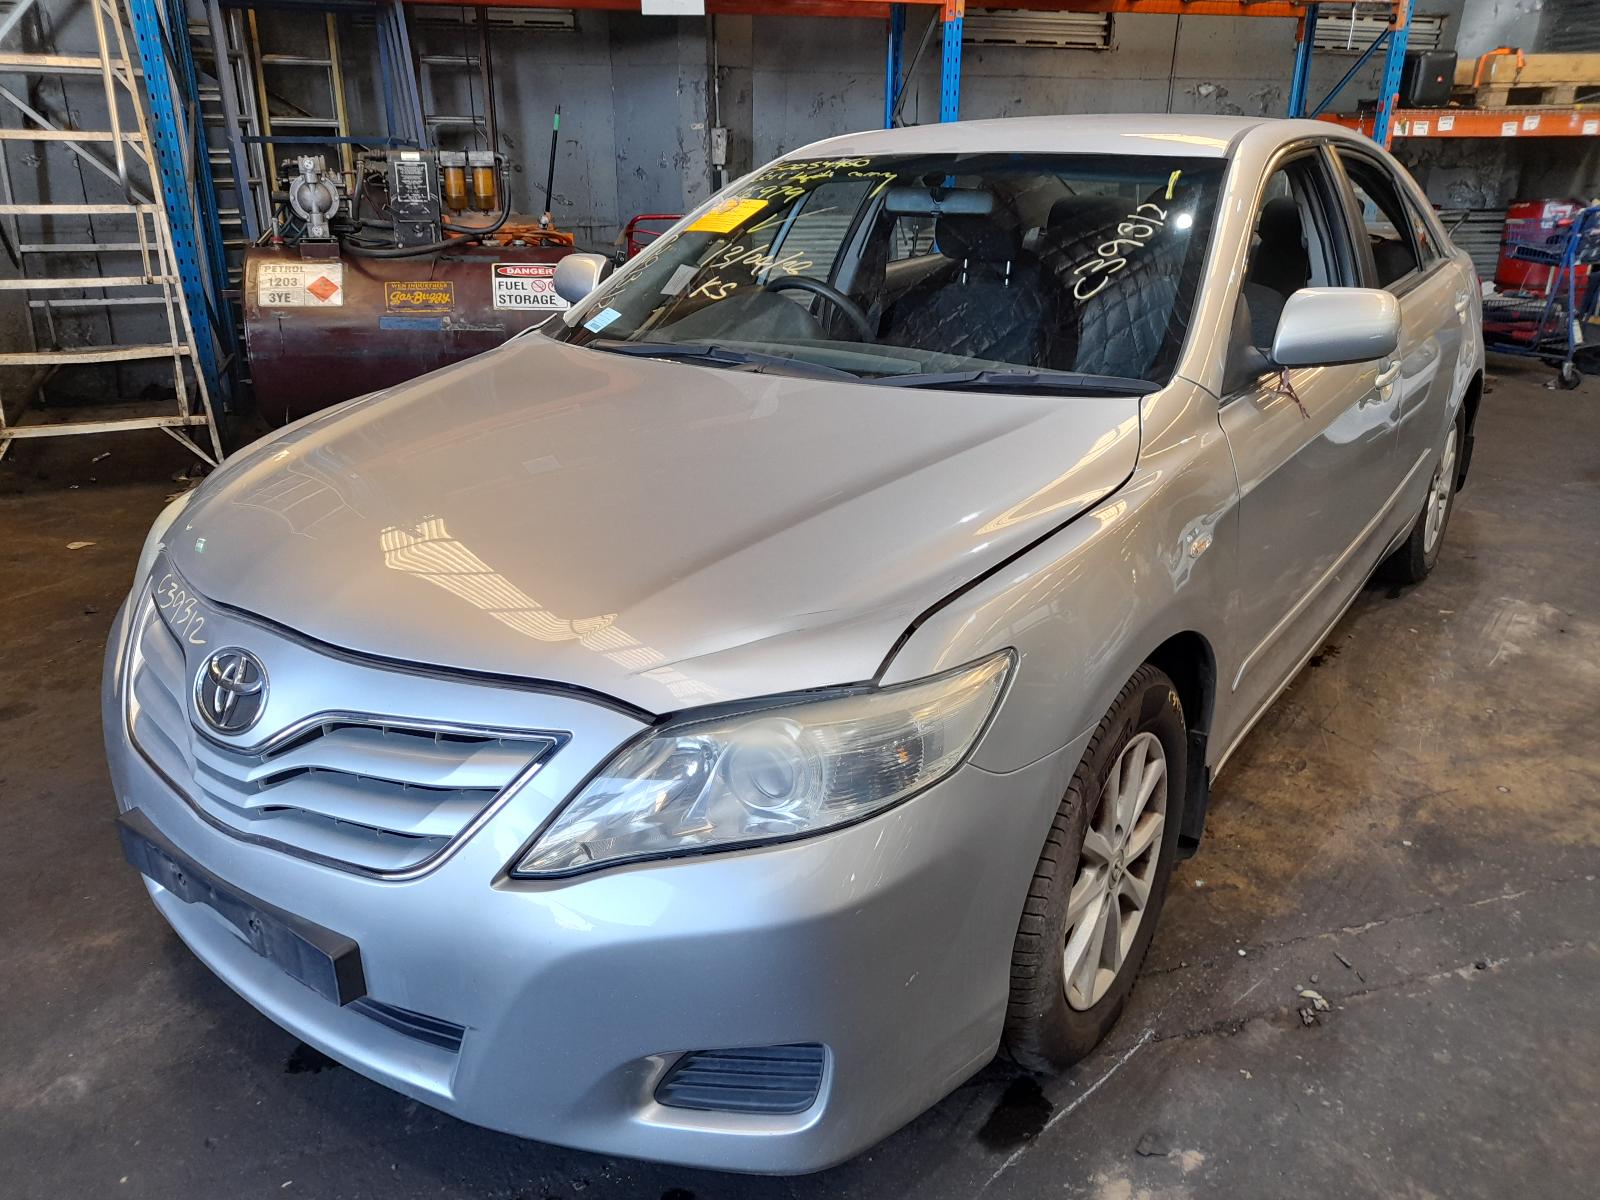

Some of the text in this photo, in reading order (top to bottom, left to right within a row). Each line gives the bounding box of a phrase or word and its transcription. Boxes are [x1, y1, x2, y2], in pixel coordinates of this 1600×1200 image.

[264, 265, 305, 273] PETROL
[506, 267, 553, 275] DANGER
[268, 277, 298, 287] 1203
[498, 281, 528, 291] FUEL
[268, 292, 292, 303] 3YE
[498, 294, 557, 305] STORAGE
